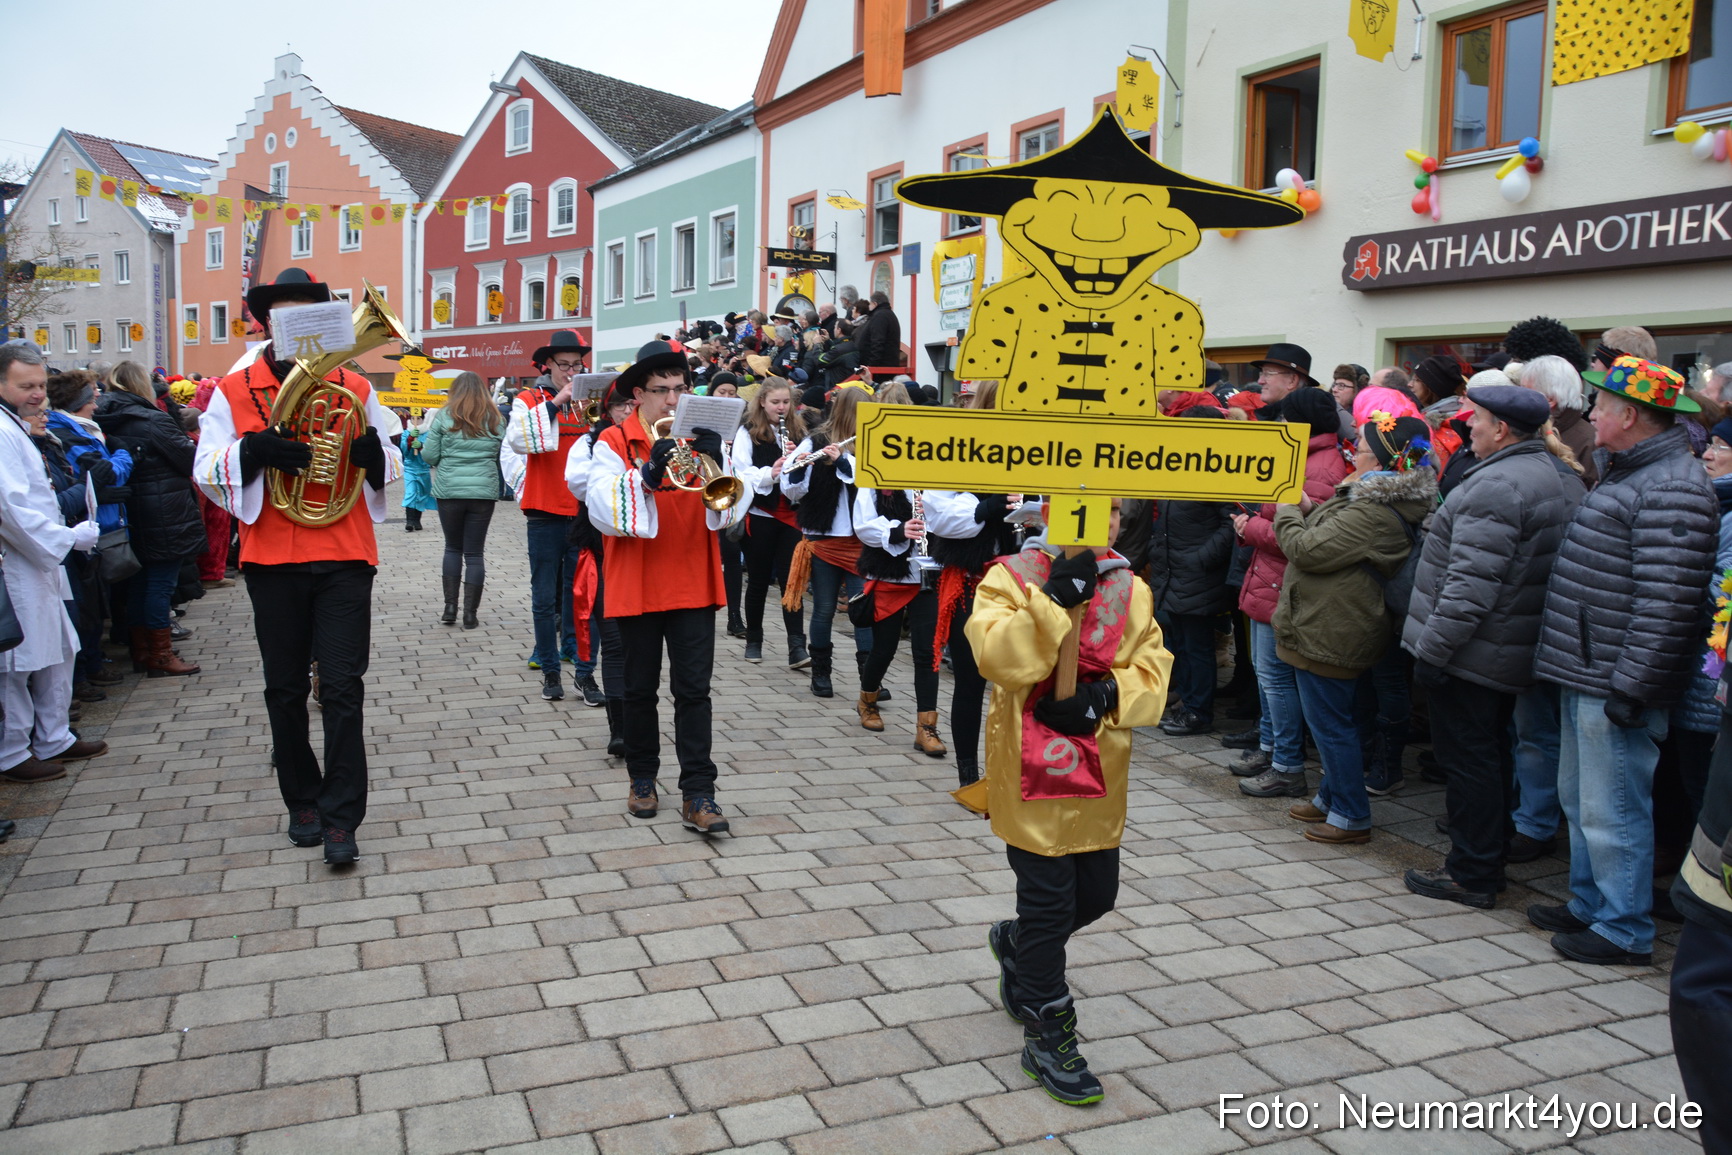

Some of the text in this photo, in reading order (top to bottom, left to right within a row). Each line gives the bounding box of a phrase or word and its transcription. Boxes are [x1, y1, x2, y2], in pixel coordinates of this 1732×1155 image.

[1384, 201, 1732, 275] RATHAUS APOTHEK
[153, 263, 161, 305] UHREN
[383, 395, 408, 404] Silbania
[414, 407, 419, 415] 2
[881, 433, 1276, 482] Stadtkapelle Riedenburg
[1070, 505, 1087, 539] 1
